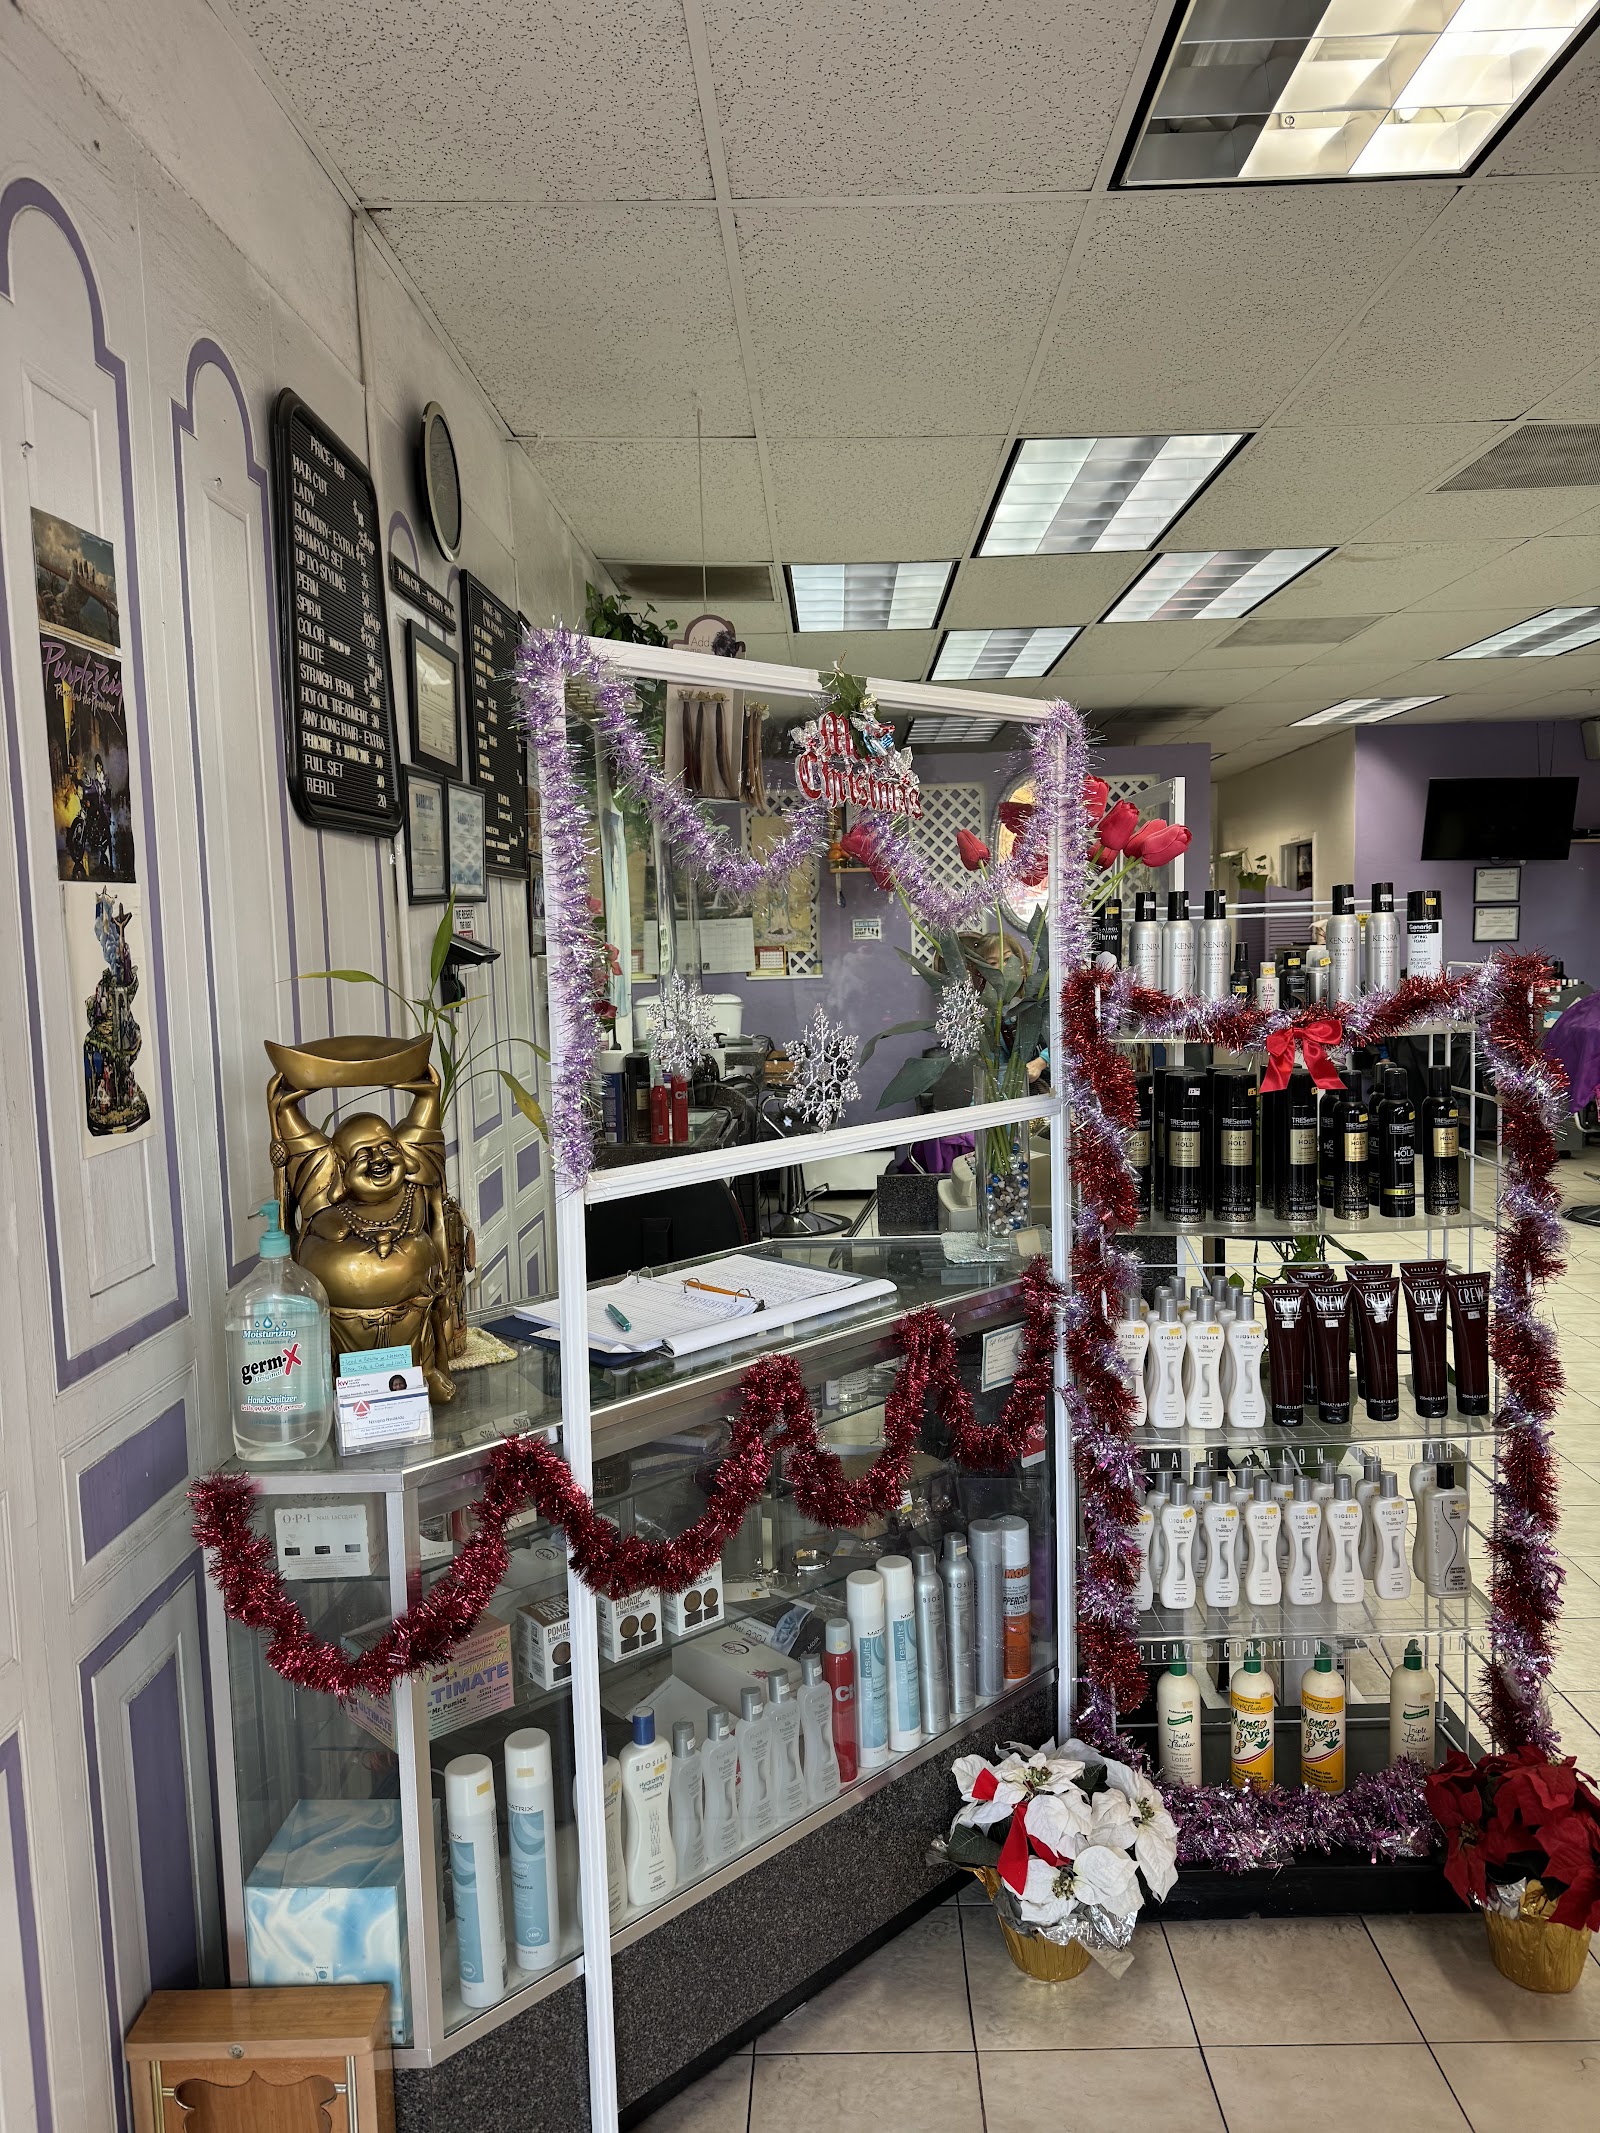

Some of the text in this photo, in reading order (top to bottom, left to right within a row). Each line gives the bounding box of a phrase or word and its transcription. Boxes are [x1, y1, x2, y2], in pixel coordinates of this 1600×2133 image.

[293, 454, 329, 496] HAIR CUT
[293, 478, 316, 507] LADY
[294, 525, 329, 560] SHAMPOO
[331, 550, 344, 571] SET
[333, 530, 355, 560] EXTRA
[295, 548, 306, 566] UP
[307, 555, 319, 575] DO
[320, 564, 347, 593] STYLING
[296, 571, 319, 598] PERM
[297, 594, 323, 622] SPIRAL
[297, 617, 325, 644] COLOR
[299, 640, 325, 666] HILITE
[41, 641, 123, 716] Purple Rain
[300, 663, 355, 700] STRAIGH PERM
[301, 686, 380, 730] HOT OIL TREATMENT 30
[303, 709, 385, 751] ANY LONG EXTRA
[336, 741, 341, 756] &
[305, 755, 326, 773] FULL
[328, 761, 344, 778] SET
[306, 777, 386, 808] REFILL 20
[799, 752, 922, 820] Christmas
[1203, 941, 1228, 949] KENRA
[1394, 1149, 1414, 1157] HOLD
[1273, 1297, 1302, 1313] CREW
[1315, 1295, 1346, 1312] CREW
[1364, 1291, 1394, 1309] CREW
[1413, 1288, 1443, 1306] CREW
[1458, 1286, 1484, 1304] CREW
[242, 1329, 297, 1339] Moisturizing
[241, 1343, 302, 1386] germ-X
[254, 1370, 283, 1383] Original
[247, 1394, 297, 1404] Hand Sanitizer
[1247, 1448, 1325, 1467] SALON
[471, 1635, 494, 1648] Solution
[897, 1623, 907, 1660] results
[1222, 1638, 1322, 1659] CONDITION
[462, 1653, 504, 1676] PUMI BAR
[427, 1661, 510, 1707] TIMATE
[864, 1677, 873, 1701] total
[1231, 1710, 1268, 1731] Mango
[1301, 1708, 1337, 1730] Mango
[1403, 1721, 1427, 1735] Triple
[1168, 1728, 1191, 1741] Triple
[636, 1753, 668, 1772] BIOSILK
[639, 1774, 664, 1789] Hydrating
[641, 1782, 664, 1794] Therapy
